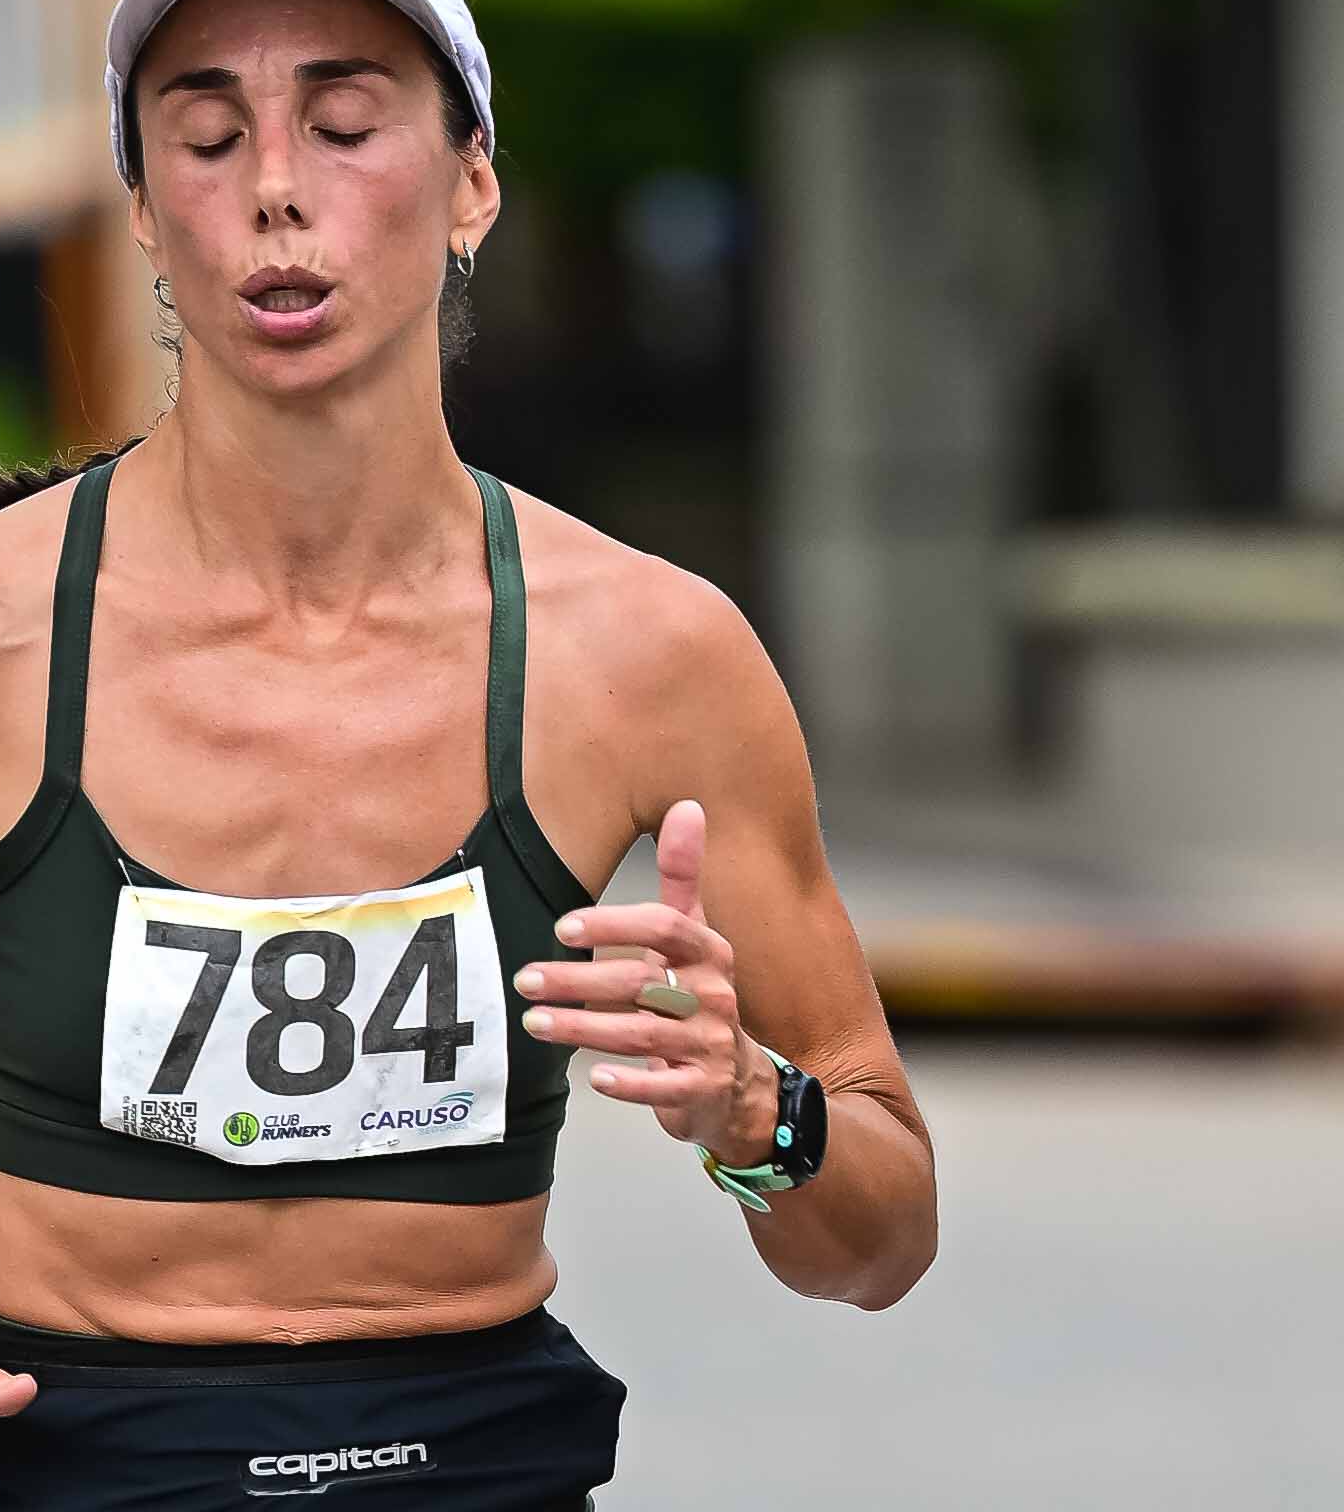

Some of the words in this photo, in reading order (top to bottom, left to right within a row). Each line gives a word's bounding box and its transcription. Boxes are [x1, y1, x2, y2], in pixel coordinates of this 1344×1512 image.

[145, 913, 475, 1096] 784
[263, 1113, 300, 1128] CLUB
[360, 1104, 469, 1130] CARUSO
[260, 1124, 332, 1141] RUNNER'S
[248, 1443, 427, 1482] capitán
